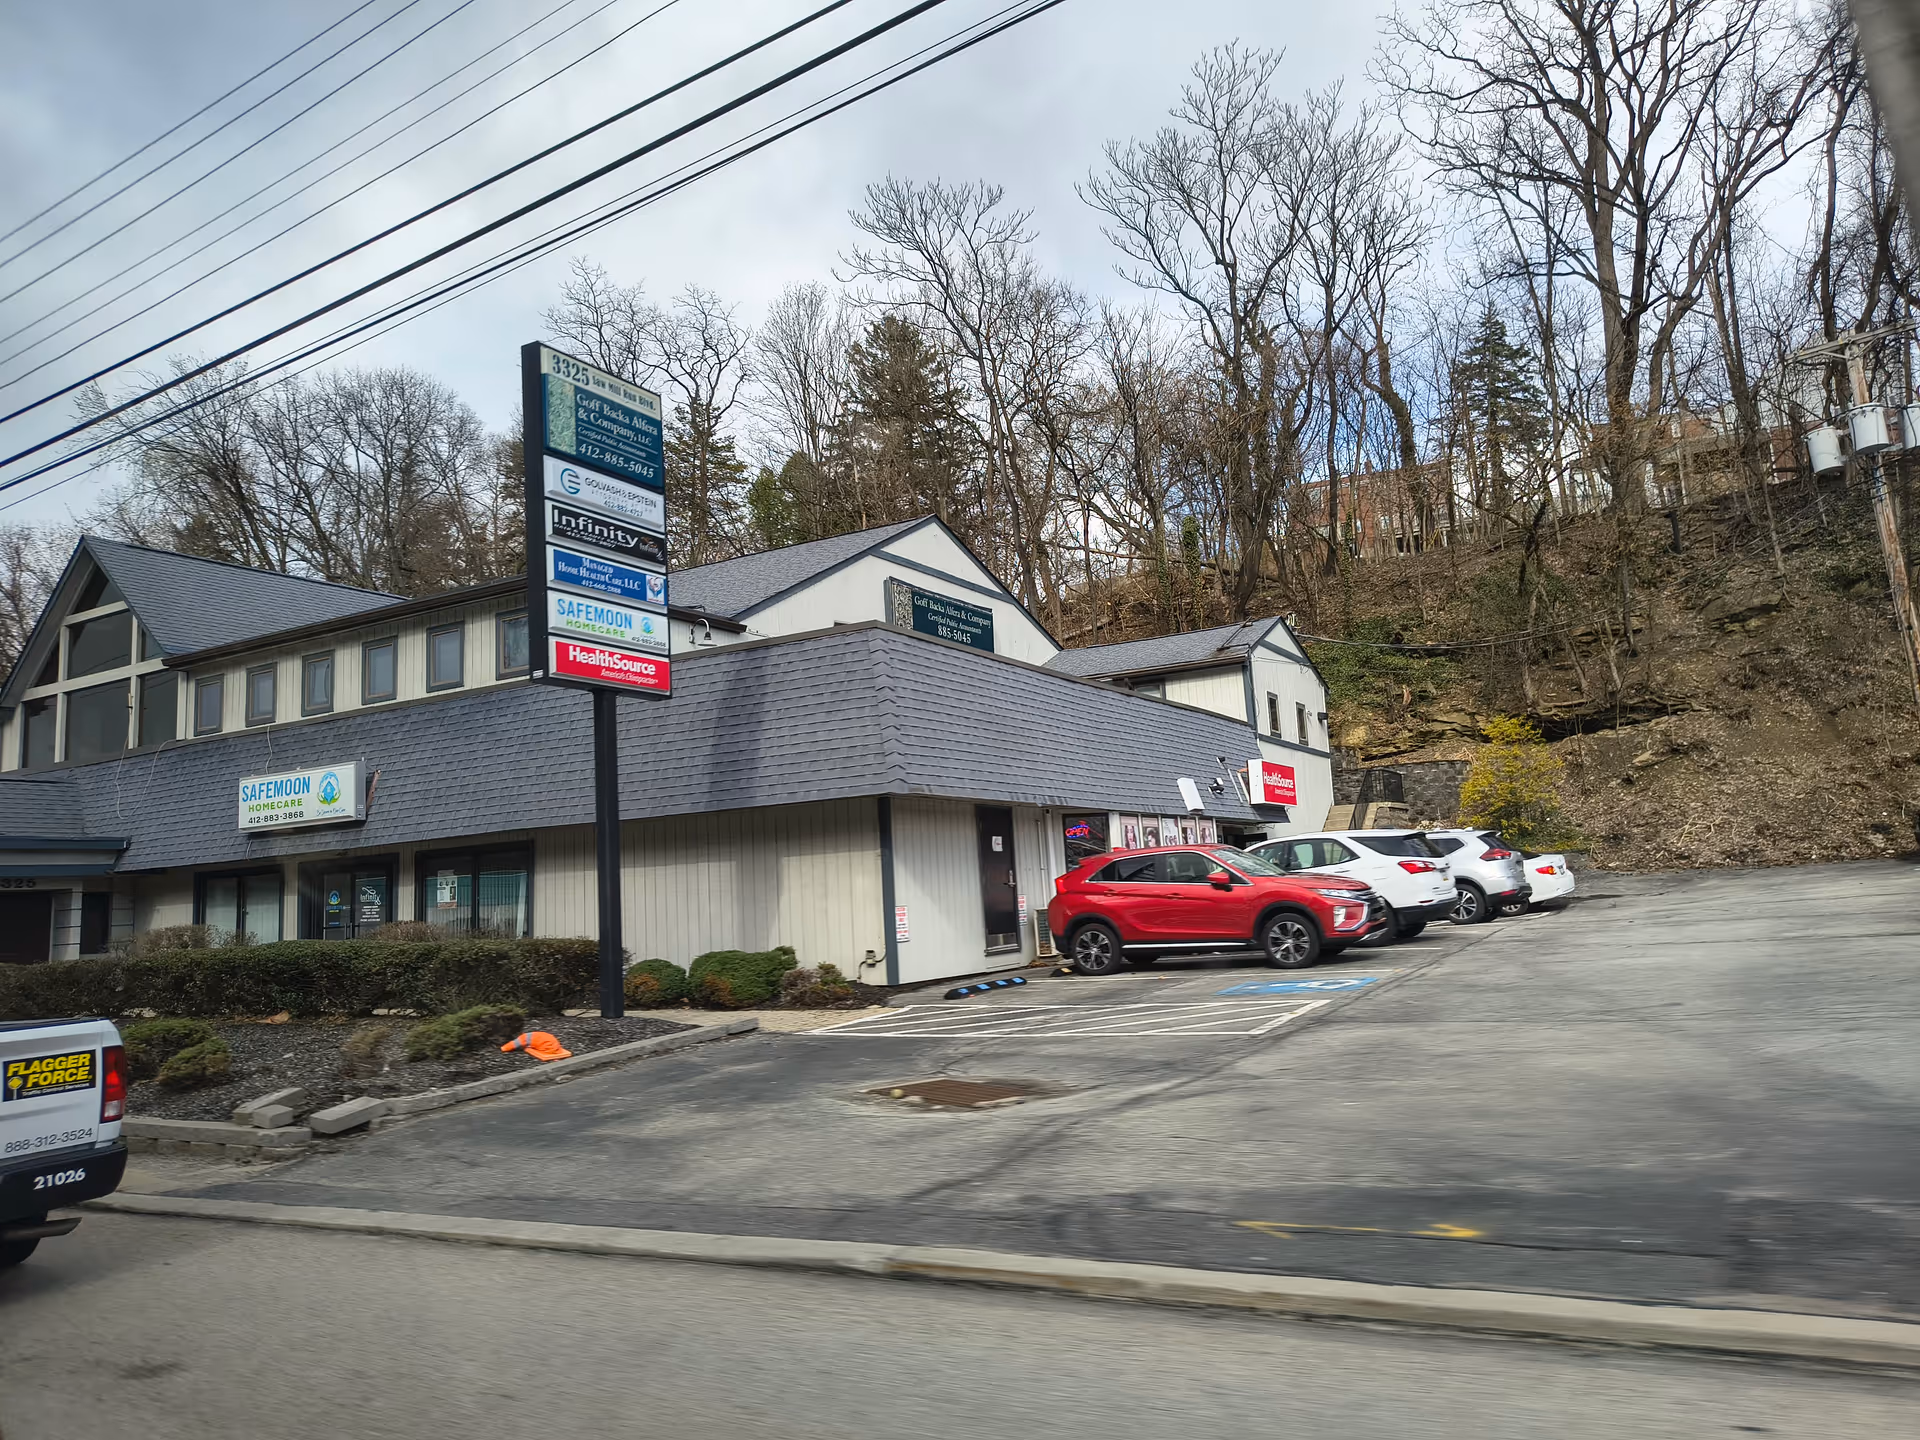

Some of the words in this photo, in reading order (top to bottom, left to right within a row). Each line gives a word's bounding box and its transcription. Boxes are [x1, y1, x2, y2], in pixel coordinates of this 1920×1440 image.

[552, 354, 590, 386] 3325
[576, 393, 601, 413] Goff
[603, 403, 630, 424] Backa
[631, 416, 658, 436] Alfera
[577, 408, 588, 421] &
[590, 412, 637, 442] Company,
[579, 442, 655, 479] 412-885-5045
[553, 509, 638, 548] Infinity
[624, 579, 641, 591] LLC
[557, 598, 633, 630] SAFEMOON
[914, 595, 928, 608] Goff
[929, 600, 945, 613] Backa
[945, 605, 961, 618] Alfera
[961, 610, 967, 619] &
[967, 612, 991, 629] Company
[566, 618, 626, 638] HOMECARE
[937, 625, 972, 644] 885-5045
[568, 645, 656, 676] HealthSource
[242, 775, 311, 803] SAFEMOON
[1263, 771, 1294, 789] HealthSource
[248, 798, 303, 813] HOMECARE
[248, 810, 304, 824] 412-883-3868
[1065, 825, 1089, 837] OPEN
[7, 1053, 91, 1077] FLAGGER
[5, 1127, 93, 1153] 888-312-3524
[33, 1168, 86, 1190] 21026
